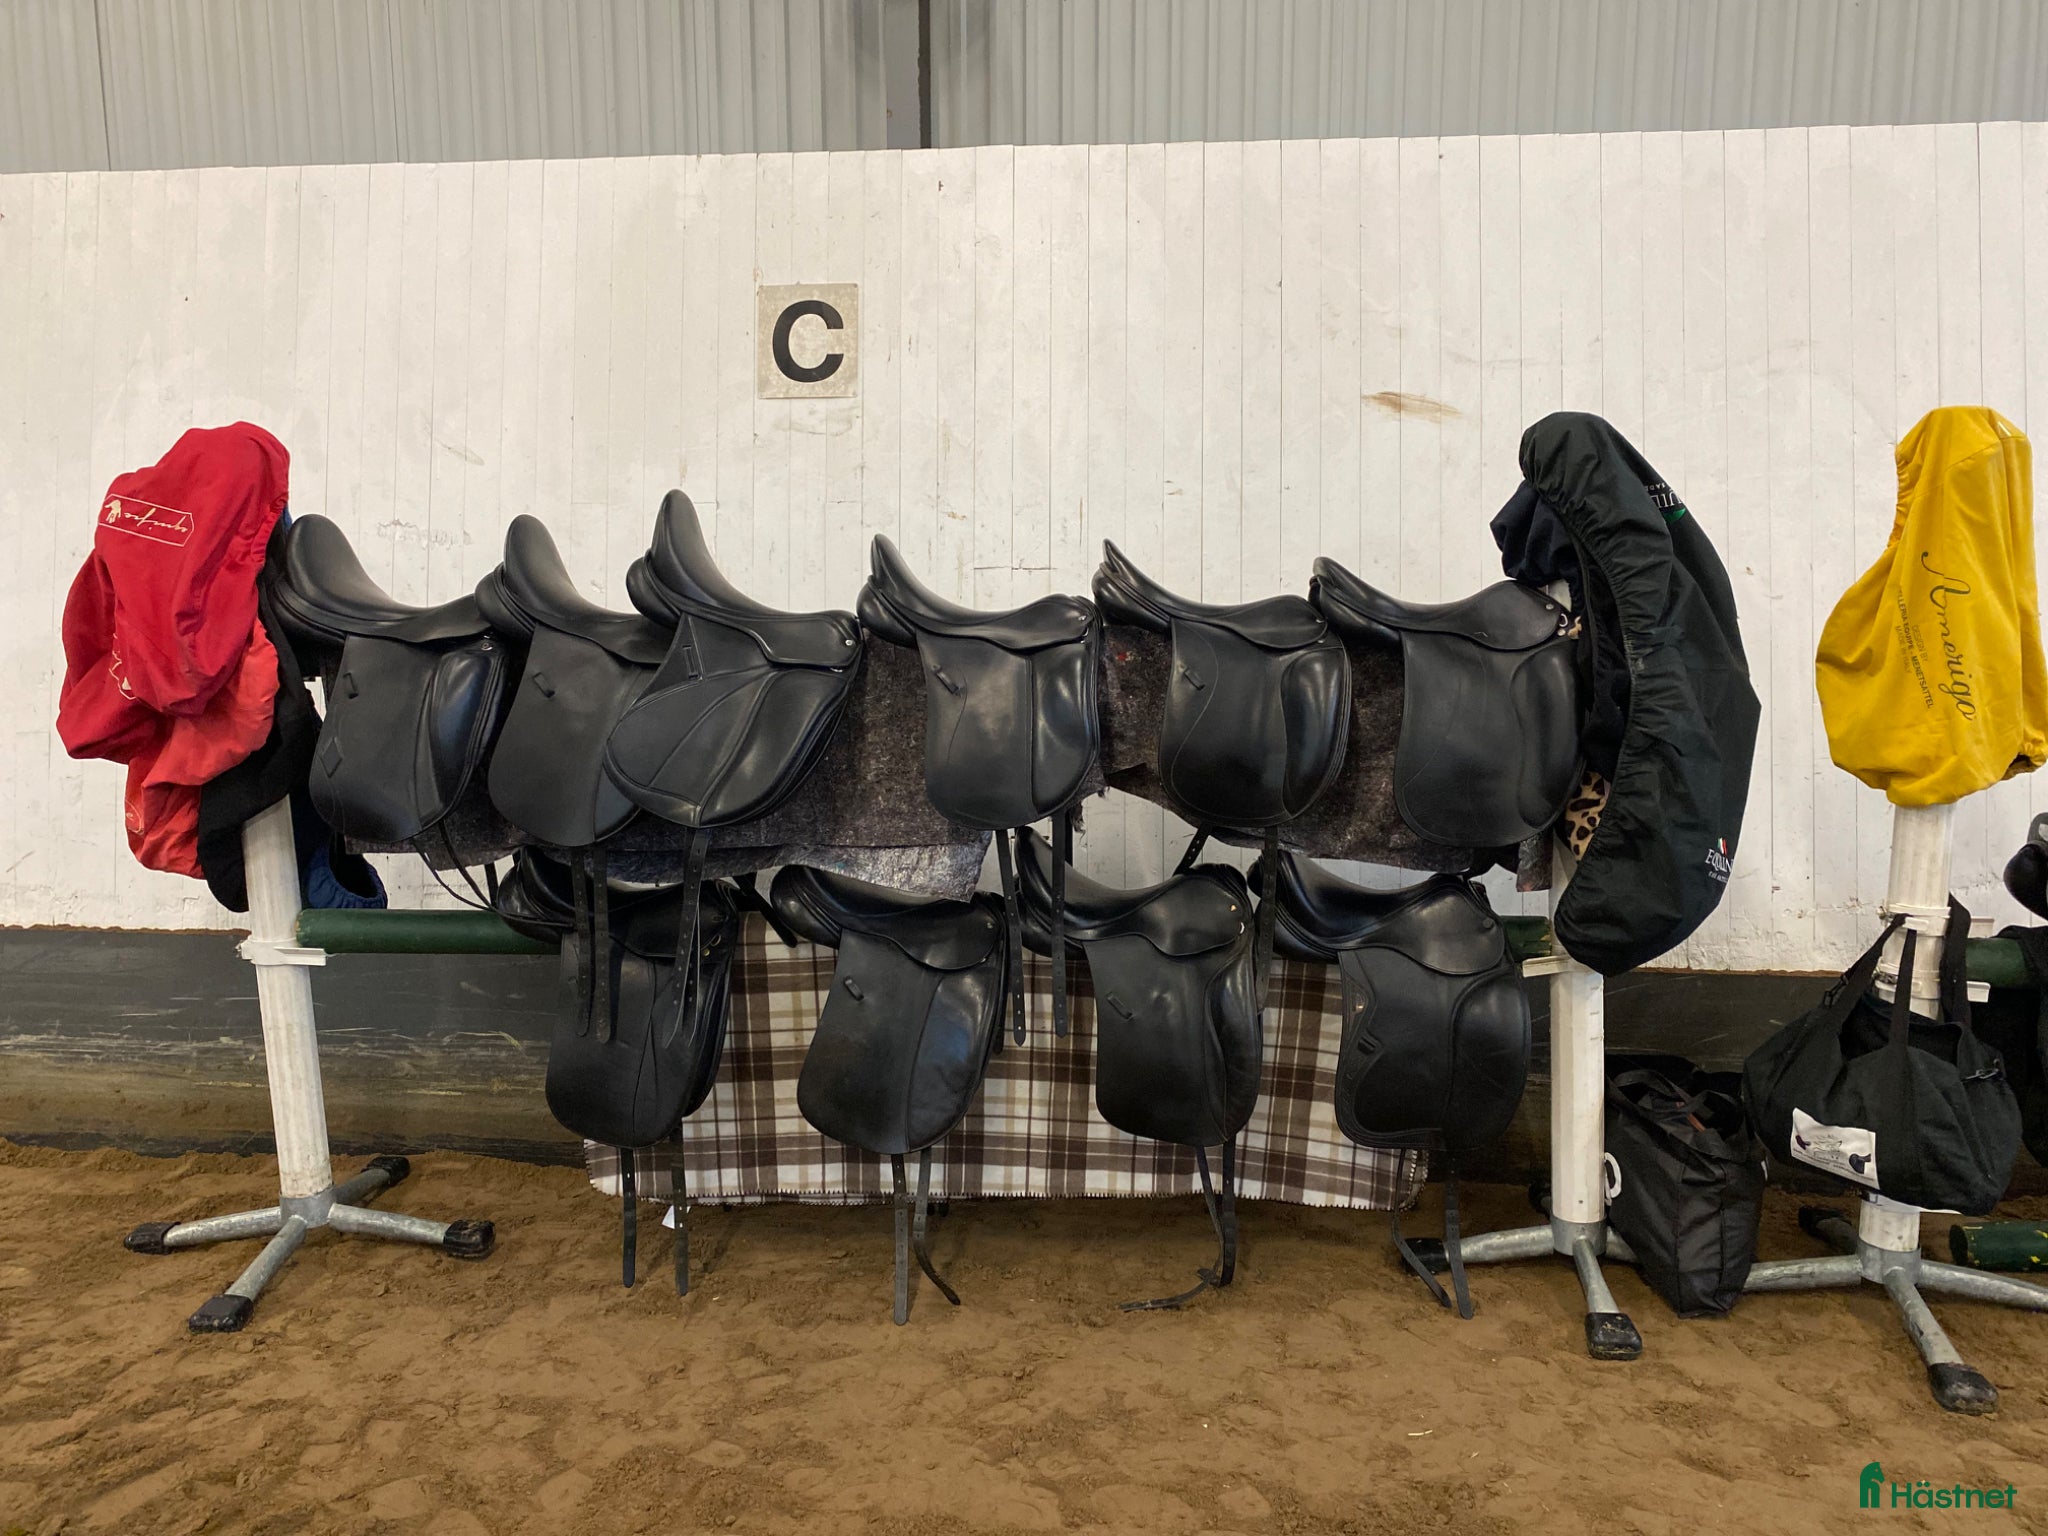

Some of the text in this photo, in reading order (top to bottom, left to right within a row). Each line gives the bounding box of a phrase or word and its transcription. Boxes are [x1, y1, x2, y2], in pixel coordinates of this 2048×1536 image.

[772, 300, 844, 383] C
[1903, 622, 1915, 650] EQUIPE
[1921, 551, 1977, 721] Amerigo
